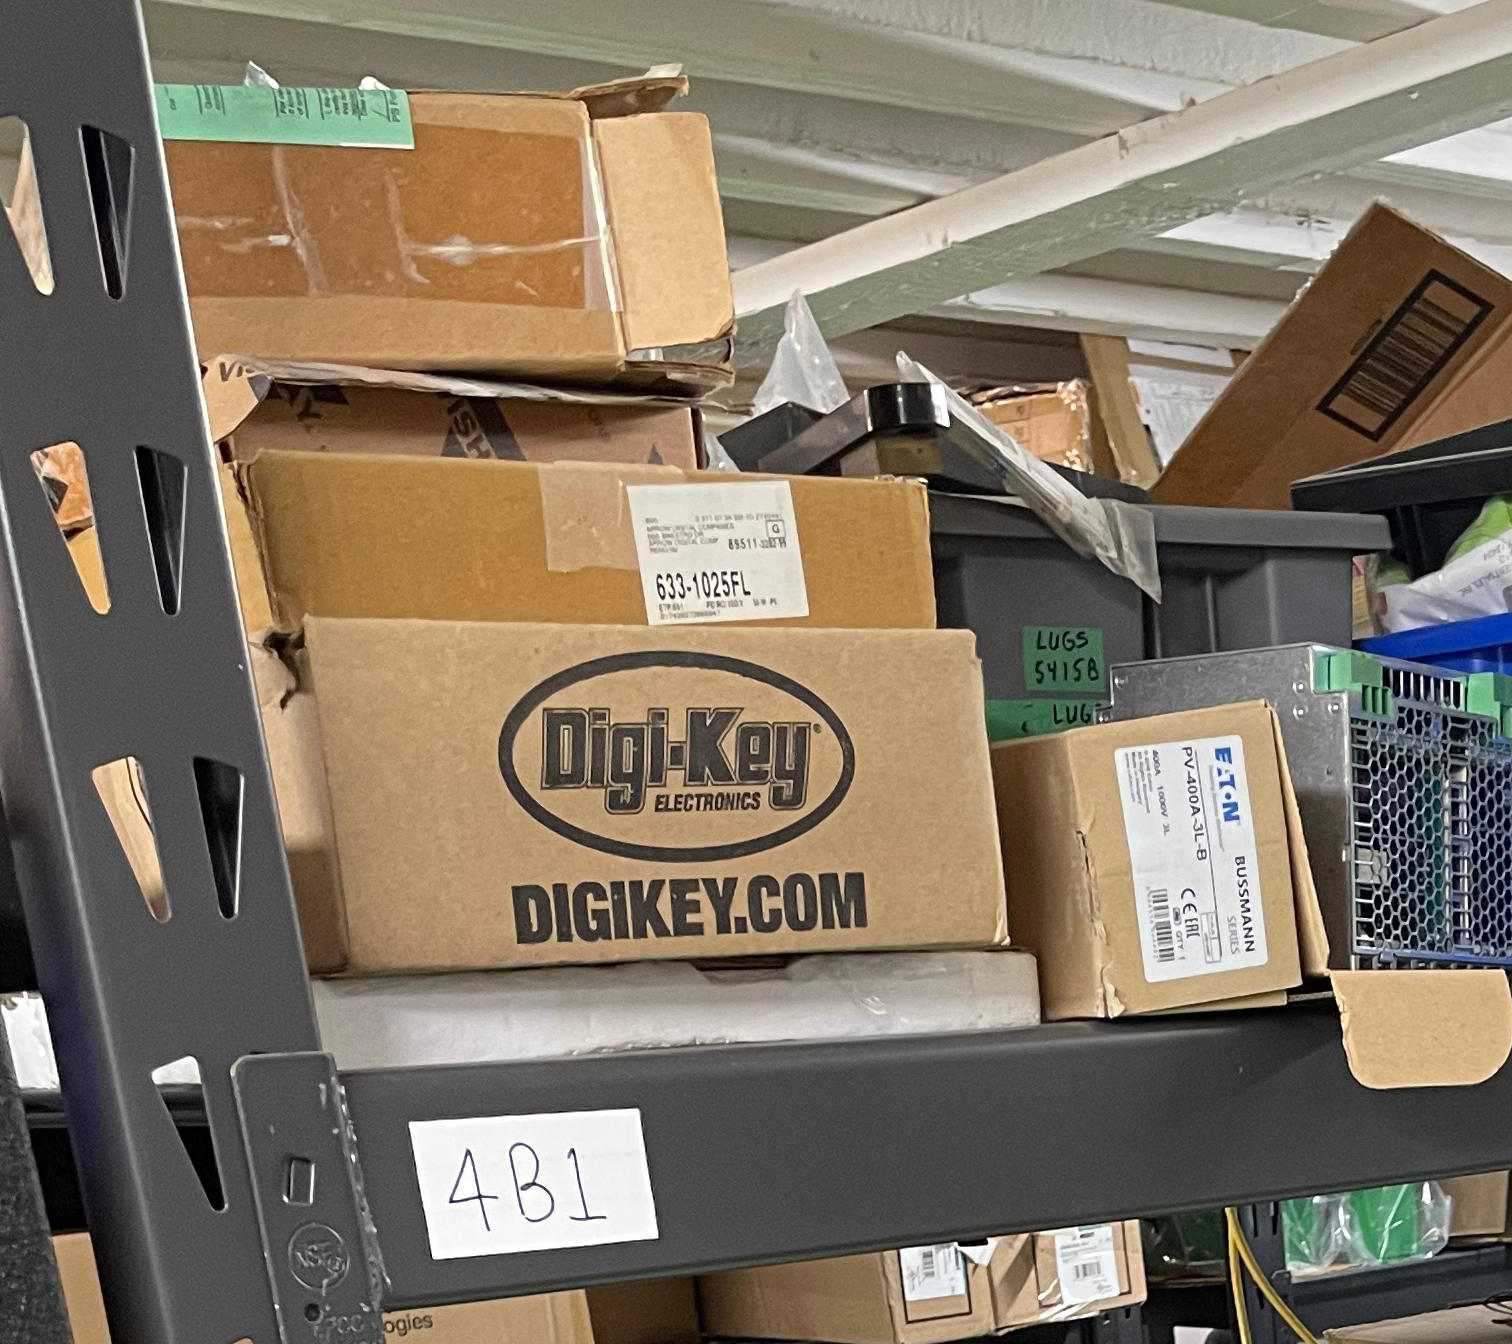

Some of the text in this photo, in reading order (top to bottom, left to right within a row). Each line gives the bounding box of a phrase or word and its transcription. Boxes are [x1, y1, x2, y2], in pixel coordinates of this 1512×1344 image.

[656, 571, 751, 600] 633-1025FL
[1036, 630, 1088, 651] LUGS
[1053, 703, 1102, 725] LUG
[540, 707, 811, 815] Digi-Key
[654, 791, 761, 813] ELECTRONICS
[1182, 746, 1208, 861] PV-400A-3L-B
[511, 872, 869, 944] DIGIKEY.COM
[1235, 855, 1256, 953] BUSSMANN
[449, 1142, 607, 1232] 4B1
